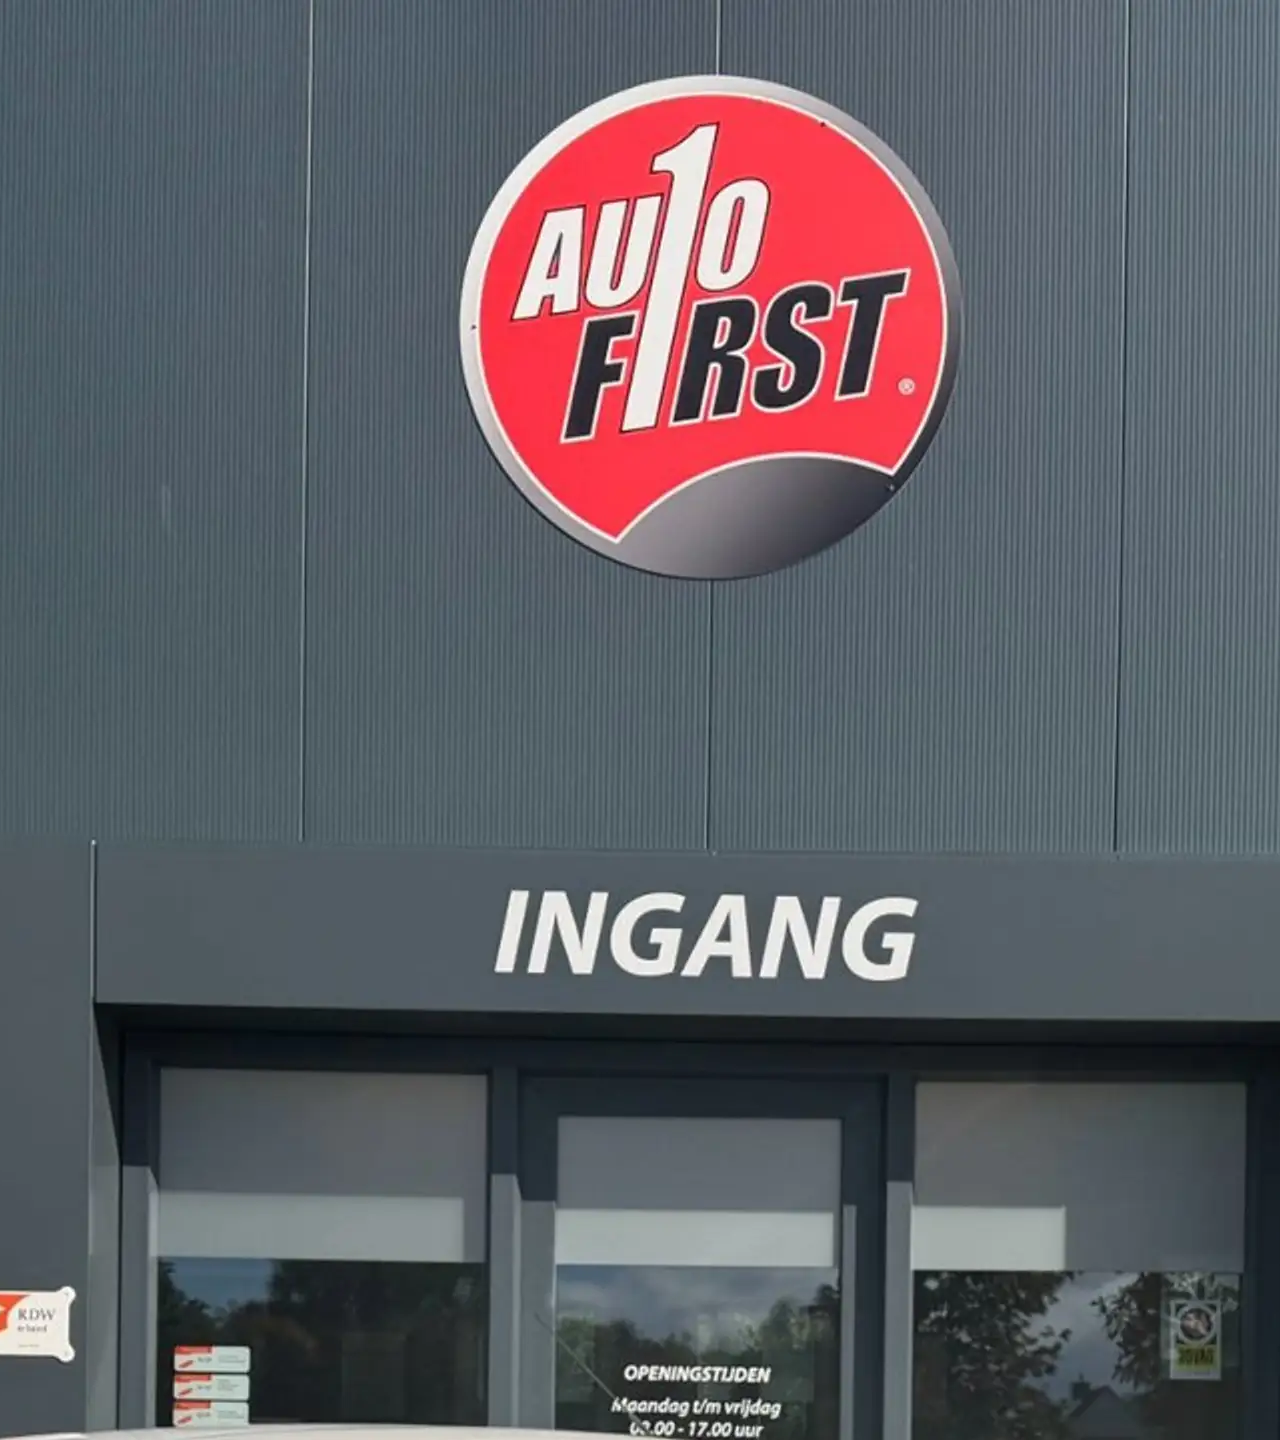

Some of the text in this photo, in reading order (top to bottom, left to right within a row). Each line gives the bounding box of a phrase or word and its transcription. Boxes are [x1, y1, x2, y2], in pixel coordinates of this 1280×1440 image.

[494, 889, 920, 982] INGANG
[18, 1307, 56, 1321] RDW
[623, 1364, 772, 1384] OPENINGSTIJDEN
[610, 1395, 782, 1419] Maandag t/m vrijdag
[688, 1421, 732, 1438] 17.00
[734, 1425, 765, 1439] uur
